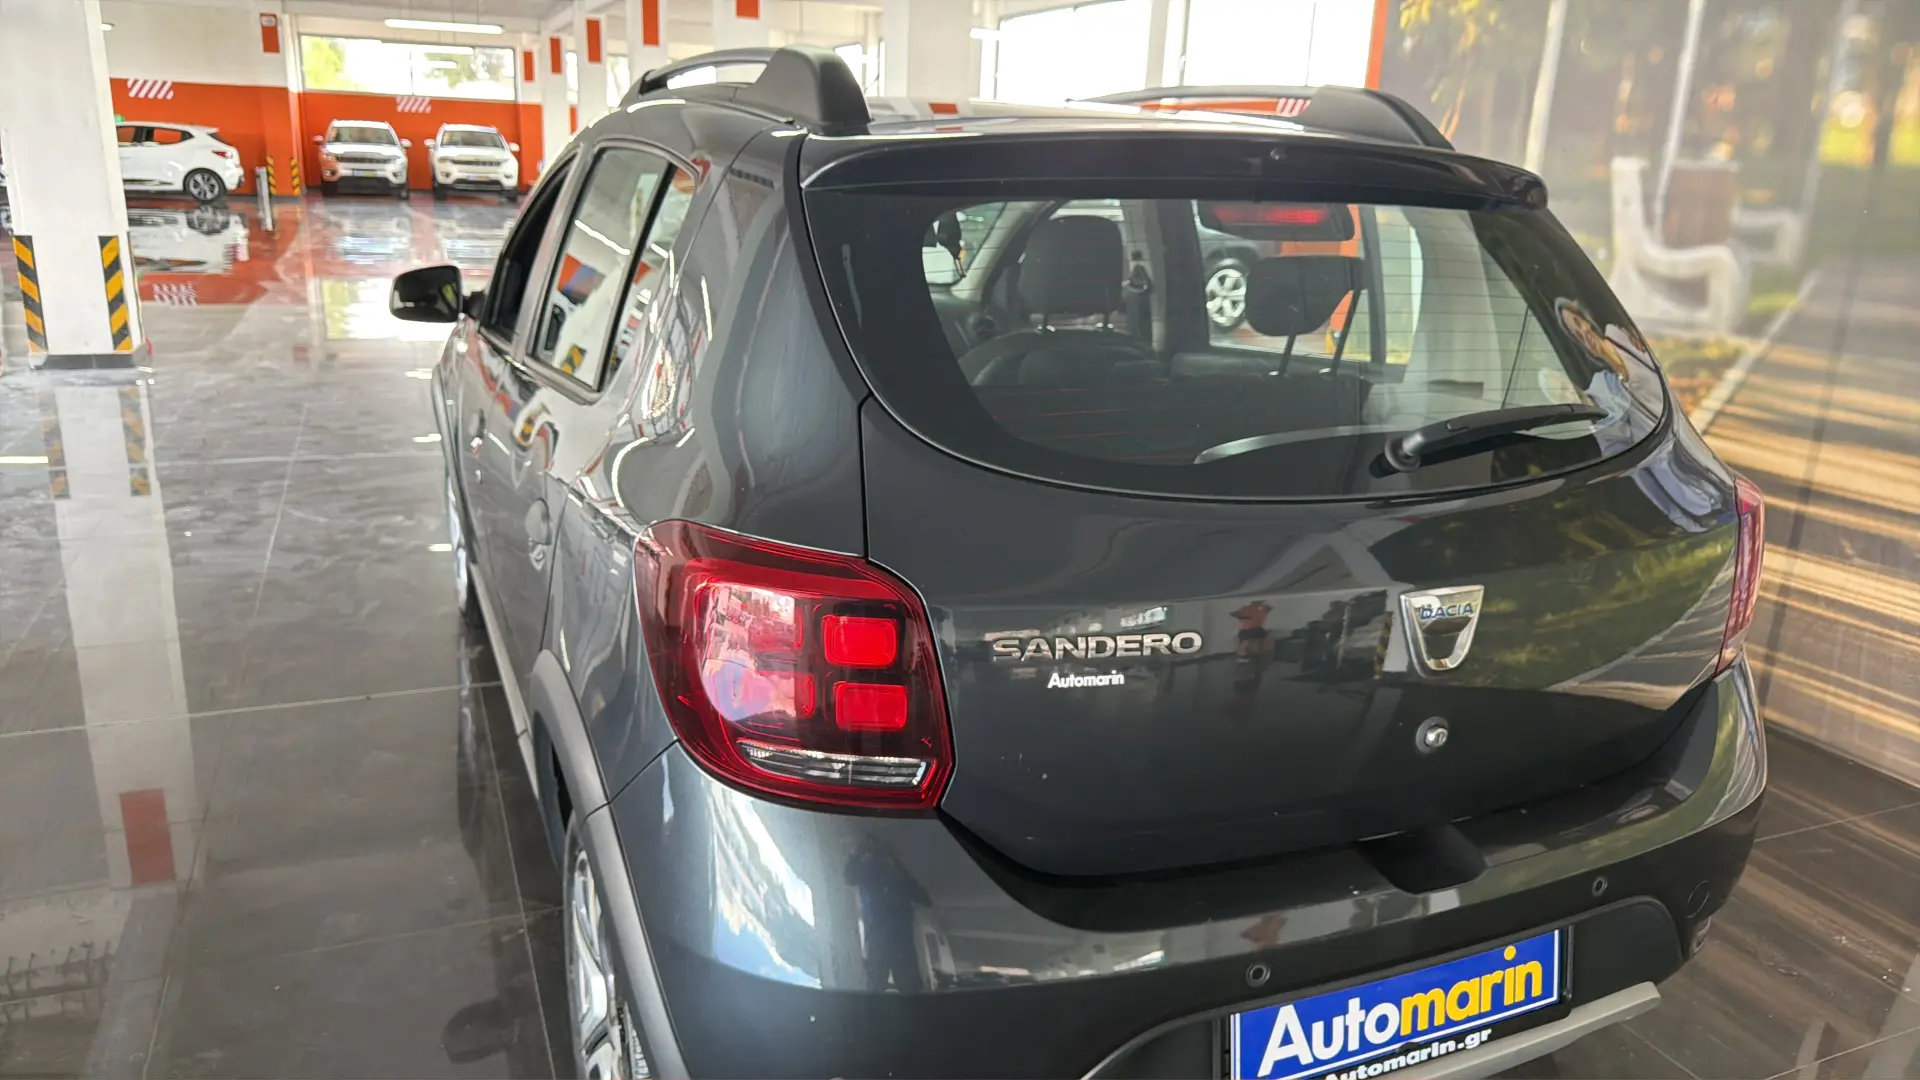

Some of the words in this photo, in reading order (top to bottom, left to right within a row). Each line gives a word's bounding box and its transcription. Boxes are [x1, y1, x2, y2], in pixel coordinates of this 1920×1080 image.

[1421, 603, 1474, 620] DACIA
[992, 632, 1203, 661] SANDERO
[1047, 670, 1125, 689] Automarin
[1258, 946, 1542, 1077] Automarin
